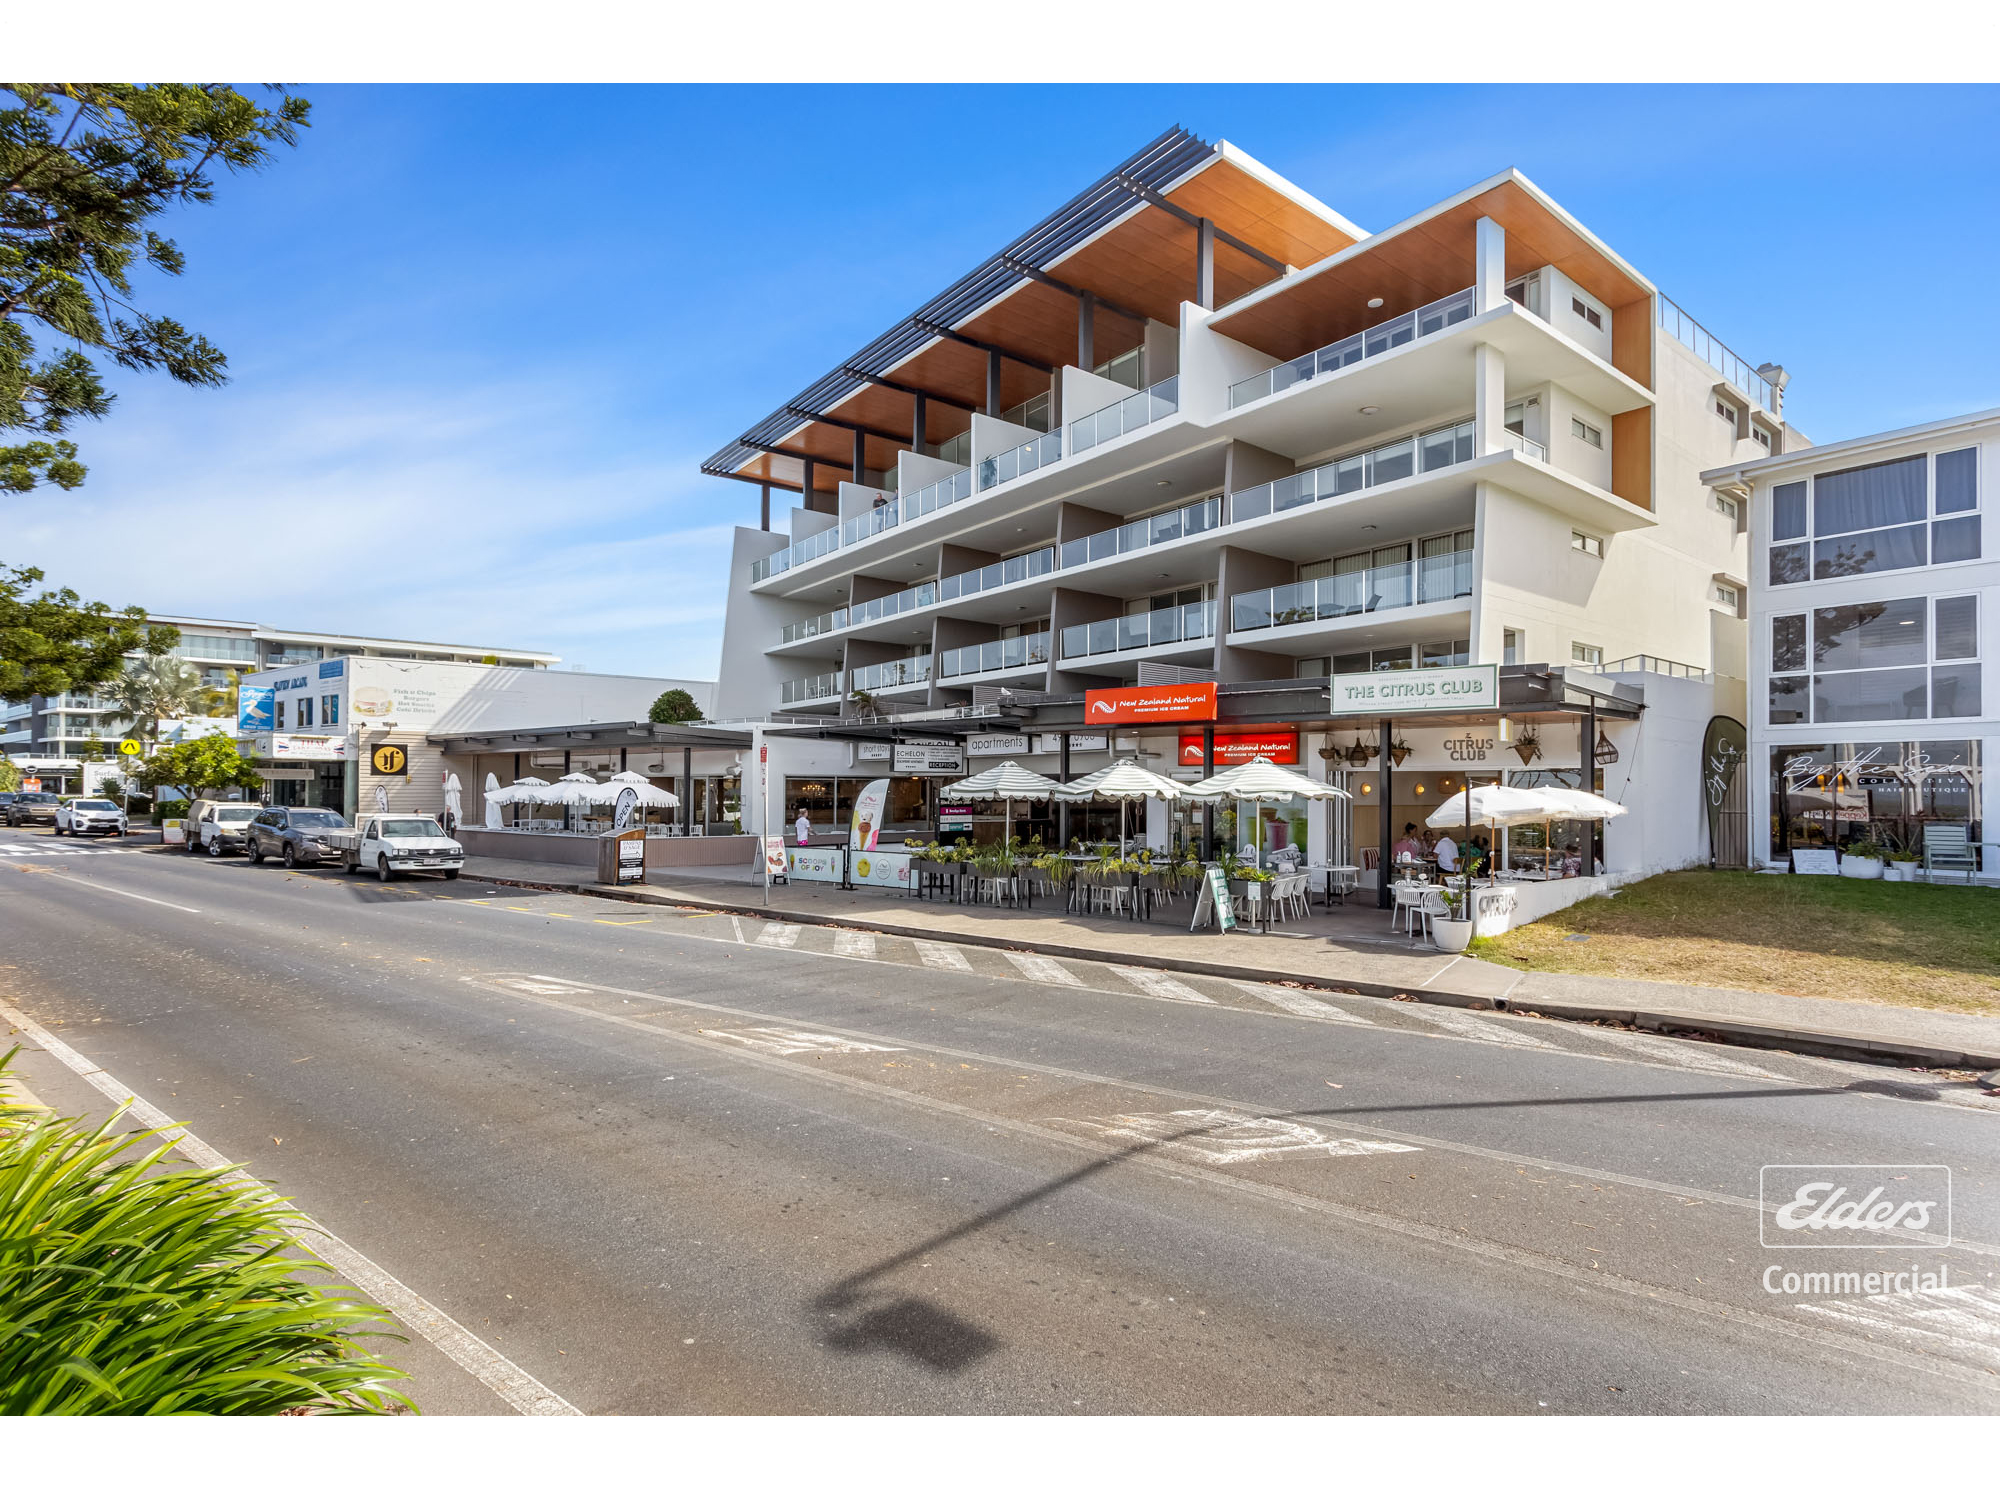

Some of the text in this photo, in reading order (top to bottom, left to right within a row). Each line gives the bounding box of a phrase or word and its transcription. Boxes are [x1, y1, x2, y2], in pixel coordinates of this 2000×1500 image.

[1344, 679, 1483, 699] THE CITRUS CLUB
[1119, 694, 1207, 707] New Zealand Natural
[971, 735, 1023, 751] apartments
[1260, 743, 1291, 751] Natural
[1443, 738, 1494, 751] CITRUS
[1450, 750, 1486, 761] CLUB
[1782, 756, 1832, 794] By
[1827, 746, 1889, 786] the
[1903, 754, 1966, 777] Sea
[616, 801, 631, 827] OPEN
[798, 857, 827, 865] SCOOPS
